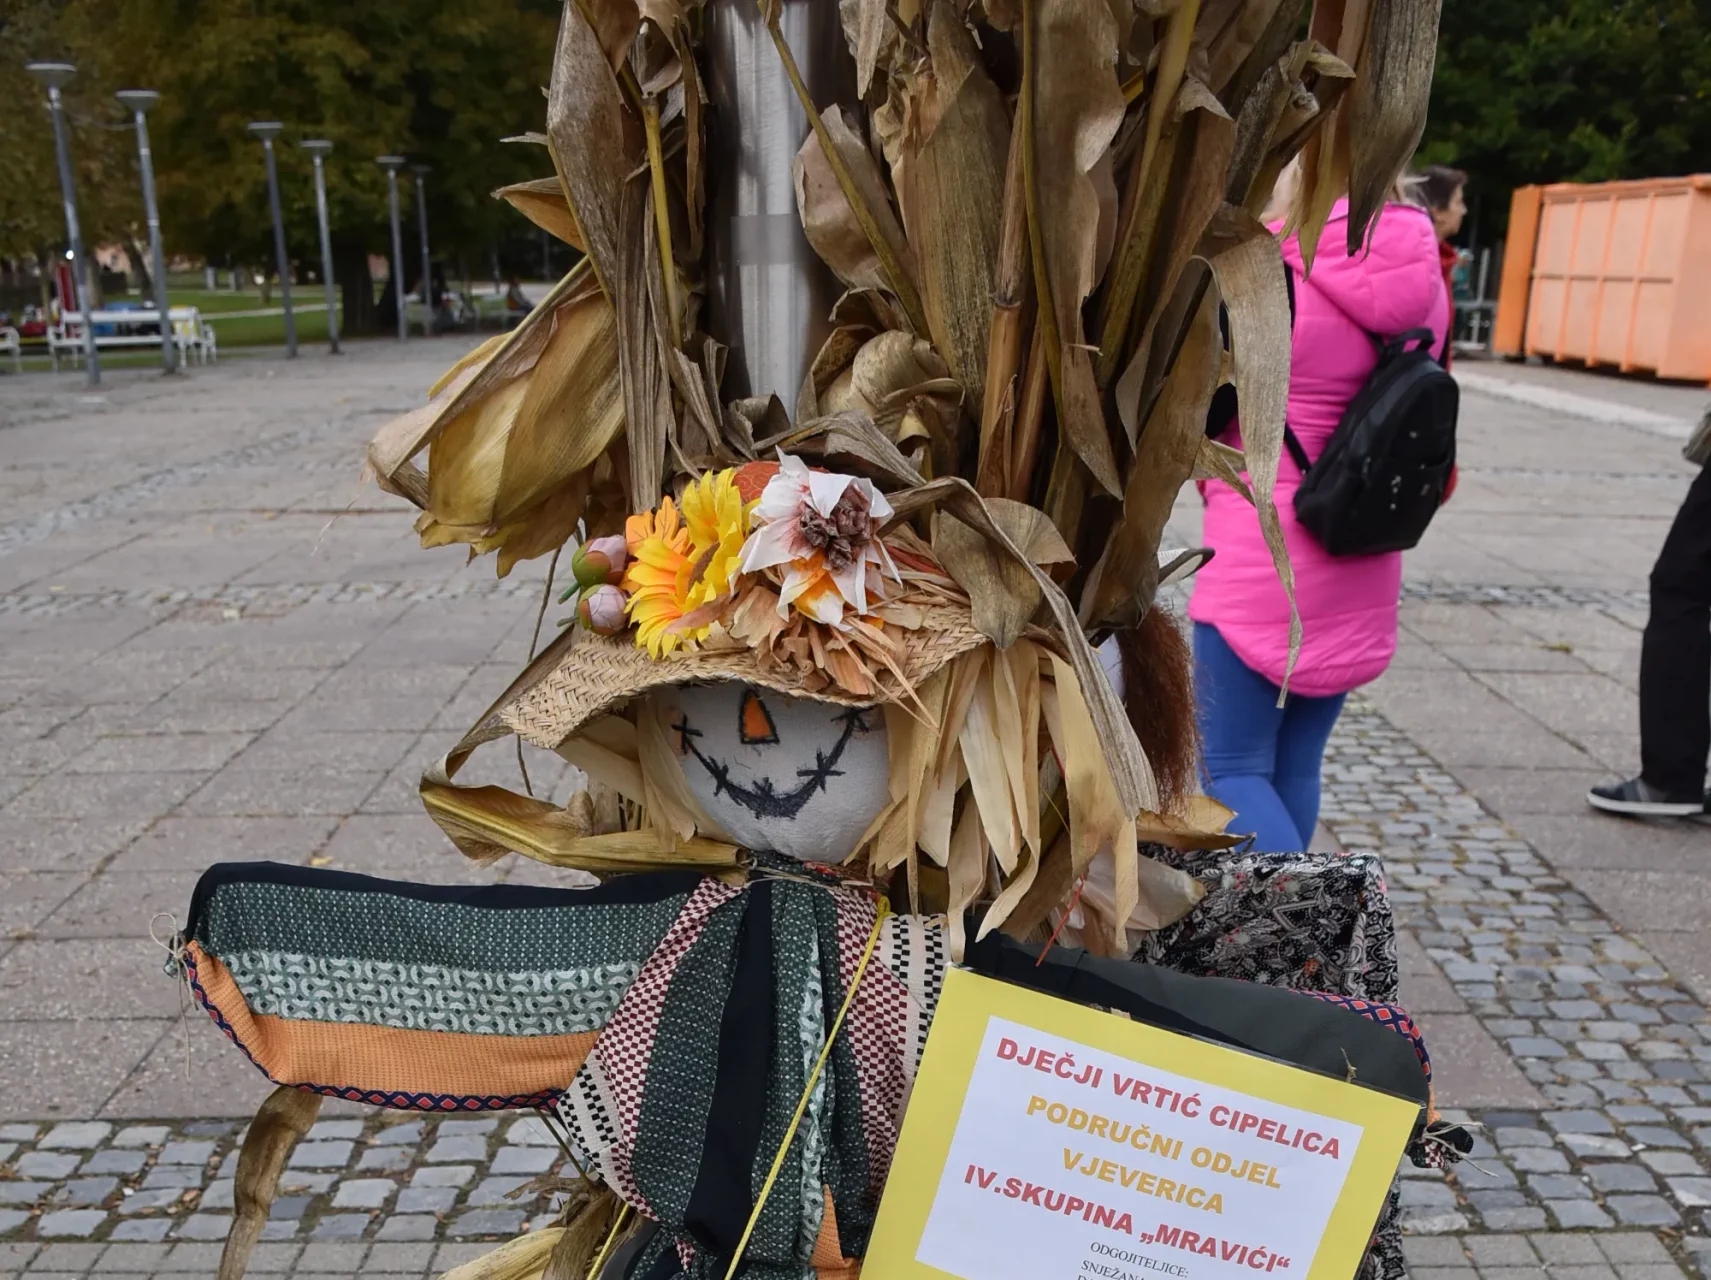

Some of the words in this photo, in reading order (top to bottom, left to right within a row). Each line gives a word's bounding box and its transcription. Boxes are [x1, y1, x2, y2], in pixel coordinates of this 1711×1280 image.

[997, 1037, 1104, 1089] DJEČJI
[1113, 1072, 1202, 1119] VRTIĆ
[1209, 1105, 1339, 1160] CIPELICA
[1025, 1094, 1185, 1161] PODRUČNI
[1190, 1146, 1281, 1190] ODJEL
[964, 1164, 1133, 1236] IV.SKUPINA
[1063, 1147, 1223, 1215] VJEVERICA
[1090, 1241, 1190, 1279] ODGOJITELJICE:
